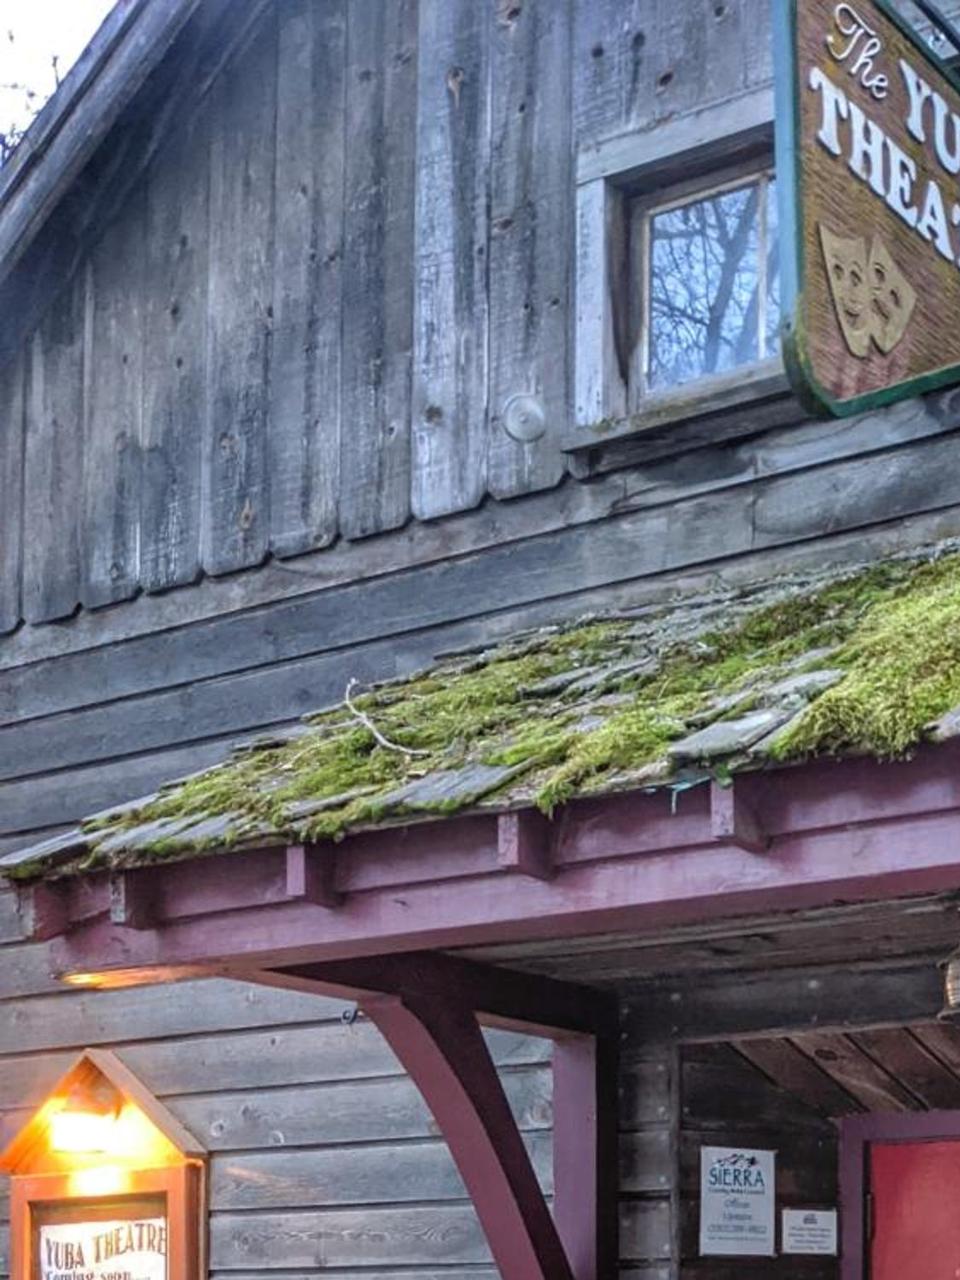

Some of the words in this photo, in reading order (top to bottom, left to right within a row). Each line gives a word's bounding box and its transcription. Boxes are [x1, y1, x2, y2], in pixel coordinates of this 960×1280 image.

[826, 3, 888, 99] The
[708, 1168, 765, 1187] SIERRA
[45, 1237, 86, 1270] YUBA
[92, 1223, 167, 1264] THEATRE
